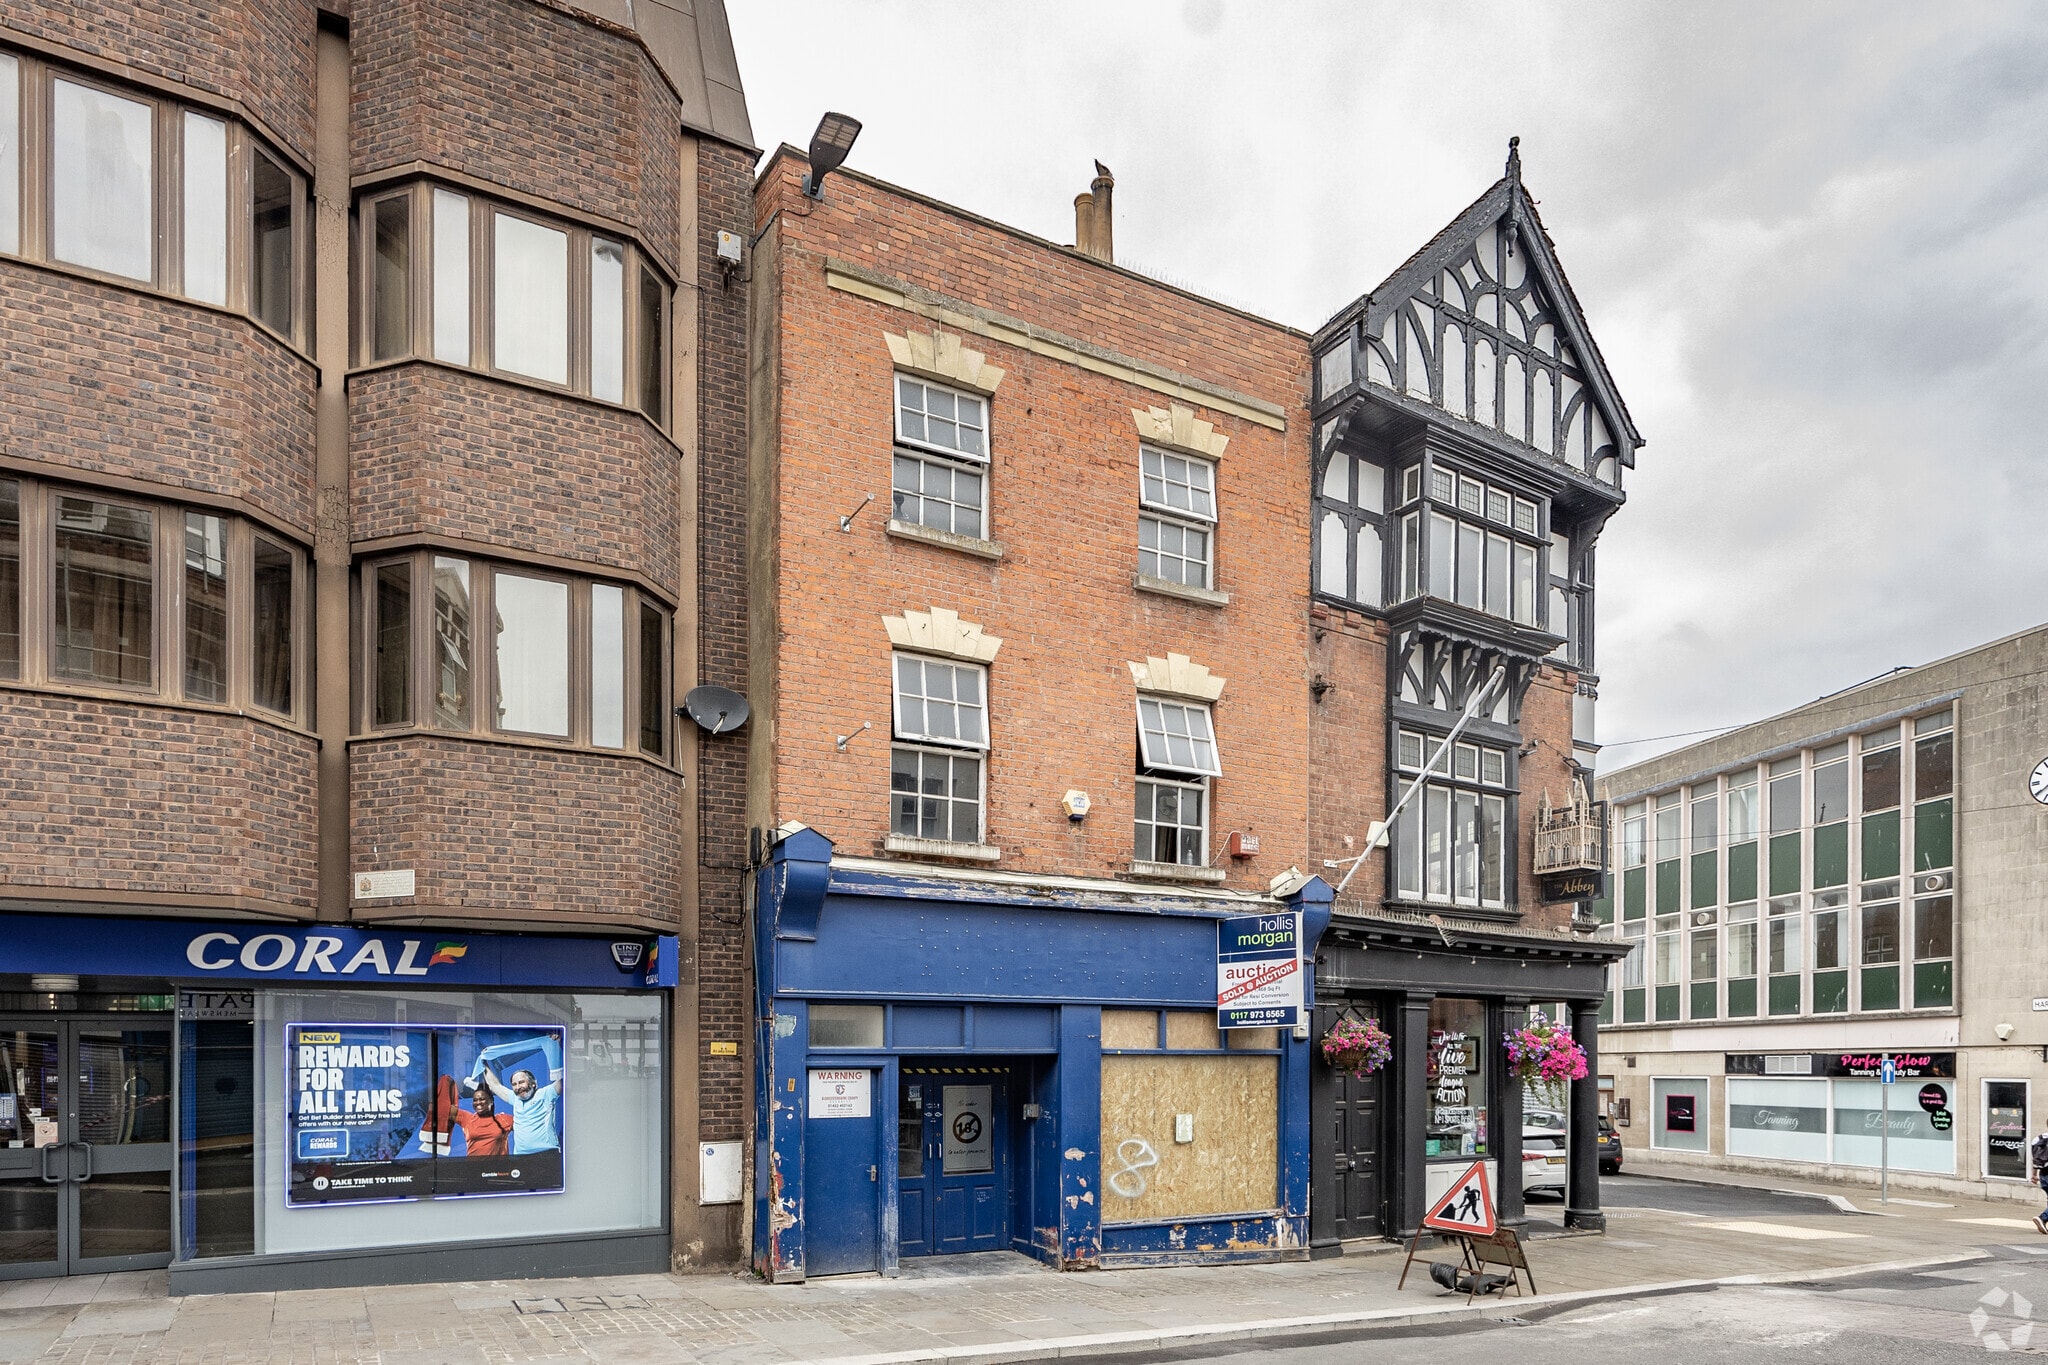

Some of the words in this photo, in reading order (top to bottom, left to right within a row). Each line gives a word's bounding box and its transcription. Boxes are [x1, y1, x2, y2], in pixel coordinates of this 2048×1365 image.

[1560, 878, 1595, 896] Abbey
[1259, 916, 1294, 932] hollis
[1238, 931, 1293, 947] morgan
[186, 932, 429, 976] CORAL
[1222, 986, 1246, 1001] SOLD
[1255, 964, 1294, 987] AUCTION
[1250, 1011, 1264, 1019] 973
[1266, 1010, 1285, 1018] 6565
[299, 1045, 410, 1068] REWARDS
[1841, 1053, 1882, 1069] Perfec
[1894, 1053, 1931, 1069] Glow
[817, 1071, 863, 1080] WARNING
[1439, 1066, 1468, 1075] PREMIER
[1850, 1068, 1875, 1077] Tanning
[1876, 1068, 1881, 1076] &
[1907, 1068, 1920, 1076] Bar
[299, 1068, 344, 1091] FOR
[299, 1090, 339, 1114] ALL
[345, 1089, 403, 1112] FANS
[1436, 1087, 1466, 1102] ACTION
[1754, 1109, 1799, 1131] Tanning
[1864, 1111, 1916, 1135] Bauty
